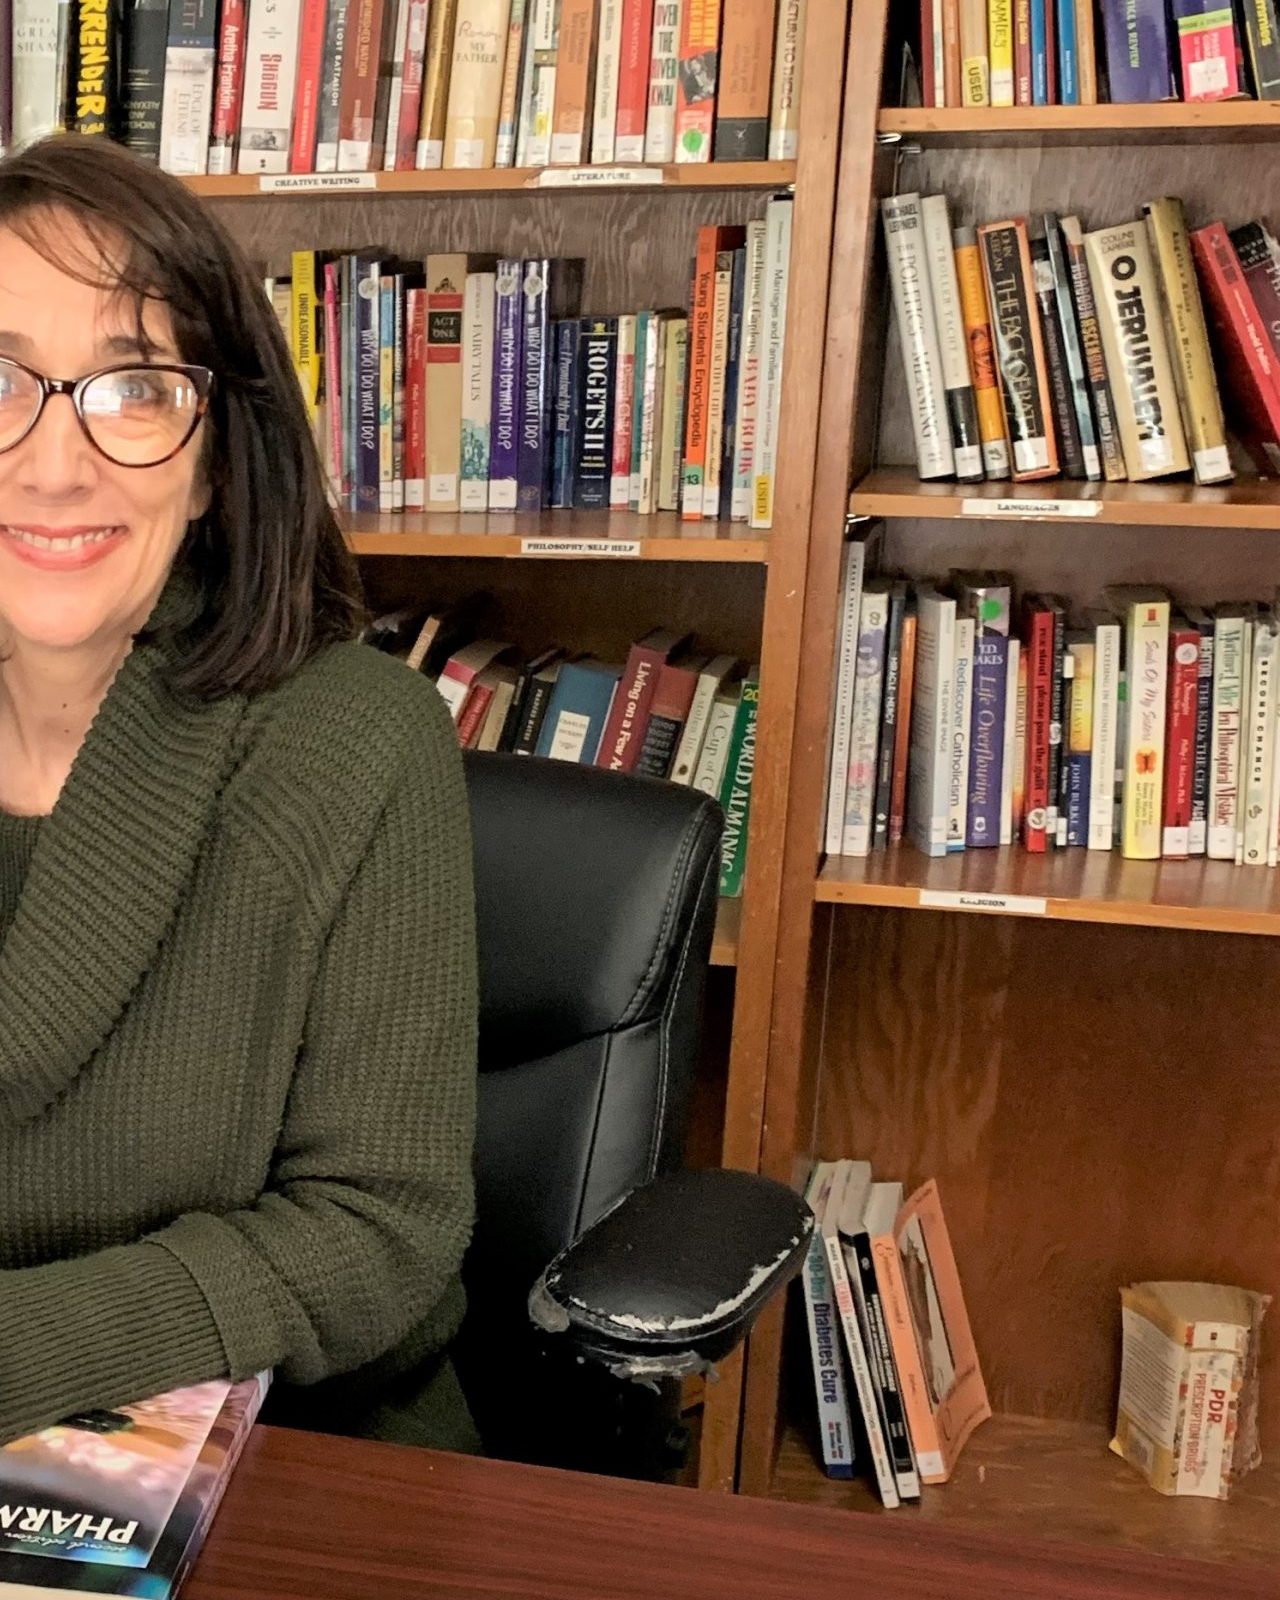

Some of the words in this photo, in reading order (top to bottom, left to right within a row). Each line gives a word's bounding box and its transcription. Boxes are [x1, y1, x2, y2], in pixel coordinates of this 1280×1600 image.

[337, 7, 346, 25] THE
[992, 0, 1008, 48] MMIES
[222, 25, 239, 62] Aretha
[335, 28, 345, 51] LOST
[469, 42, 486, 52] MY
[659, 31, 674, 52] THE
[1128, 33, 1141, 68] REVIEW
[75, 0, 110, 118] RRENDER
[357, 51, 370, 77] NATION
[455, 53, 498, 64] FATHER
[783, 46, 796, 64] TO
[219, 66, 238, 110] Franklin
[331, 54, 343, 107] BATTALION
[967, 66, 984, 103] USED
[274, 179, 319, 187] CREATIVE
[321, 177, 360, 185] WRITING
[572, 172, 631, 181] LITERATURE
[754, 227, 766, 260] Better
[991, 231, 1004, 273] KEEGAN
[751, 261, 764, 299] Homes
[1111, 255, 1137, 281] O
[695, 271, 711, 308] Young
[769, 269, 784, 318] Marriages
[899, 255, 925, 336] POLITICS
[996, 273, 1021, 316] THE
[298, 293, 311, 366] UNREASONABLE
[432, 329, 456, 339] ONE
[433, 317, 456, 326] ACT
[748, 308, 762, 355] Gardens
[769, 321, 781, 339] and
[360, 330, 376, 350] WHY
[473, 323, 483, 360] FAIRY
[500, 327, 515, 352] WHY
[526, 327, 541, 350] WHY
[694, 311, 709, 366] Students
[1000, 317, 1026, 359] FACE
[1081, 317, 1106, 383] ASCENDING
[1246, 323, 1261, 346] World
[1256, 346, 1271, 376] Politics
[360, 353, 375, 368] DO
[500, 353, 514, 366] DO
[526, 352, 539, 366] DO
[712, 340, 724, 395] BEAUTIFUL
[767, 341, 780, 381] Families
[1114, 285, 1166, 442] JERUSALEM
[360, 375, 375, 389] DO
[471, 362, 481, 401] TALES
[525, 373, 539, 387] DO
[558, 357, 572, 397] Promised
[584, 340, 609, 429] ROGET'S
[744, 358, 759, 408] BABY
[361, 390, 375, 418] WHAT
[498, 388, 513, 417] WHAT
[524, 388, 539, 417] WHAT
[555, 398, 570, 412] My
[690, 368, 706, 448] Encyclopedia
[710, 397, 720, 418] LIFE
[911, 350, 939, 439] MEANING
[524, 426, 539, 449] DO?
[557, 414, 569, 432] Dad
[360, 426, 375, 450] DO?
[497, 426, 512, 450] DO?
[583, 433, 605, 450] II
[738, 417, 755, 476] BOOK
[686, 474, 700, 486] 13
[756, 482, 769, 515] USED
[997, 503, 1060, 511] LANGUAGES
[527, 542, 609, 553] PHILOSOPHY/SELF
[611, 544, 635, 553] HELP
[1037, 649, 1048, 676] stout
[1144, 640, 1160, 667] Souls
[1198, 636, 1213, 678] MENTOR
[1219, 630, 1241, 675] Mortimer
[627, 661, 651, 703] Living
[888, 657, 898, 690] MIRACLE
[942, 680, 950, 696] THE
[1142, 668, 1159, 683] Of
[954, 658, 968, 728] Rediscover
[977, 674, 997, 706] Life
[1034, 685, 1046, 719] please
[1139, 687, 1158, 708] My
[1199, 682, 1210, 706] THE
[1258, 660, 1269, 718] SECOND
[622, 719, 632, 729] a
[626, 704, 638, 717] on
[718, 710, 730, 721] A
[885, 696, 896, 725] MERCY
[1198, 710, 1209, 732] KID
[1218, 709, 1239, 726] Ten
[709, 725, 728, 753] Cup
[1033, 720, 1045, 746] pass
[1140, 711, 1157, 742] Sisters
[615, 731, 633, 753] Few
[734, 725, 756, 784] WORLD
[1035, 747, 1045, 764] the
[1196, 741, 1208, 767] THE
[1214, 728, 1239, 784] Philosophical
[1254, 726, 1264, 783] CHANCE
[705, 761, 715, 772] of
[950, 732, 966, 806] Catholicism
[972, 709, 996, 805] Overflowing
[1070, 762, 1081, 790] JOHN
[1194, 768, 1206, 796] CEO
[1214, 786, 1237, 826] Mistakes
[720, 788, 749, 872] ALMANAC
[959, 897, 1007, 907] RELIGION
[812, 1302, 835, 1367] Diabetes
[820, 1368, 838, 1405] Cure
[1188, 1372, 1207, 1439] PRESCRIPTION
[1206, 1388, 1226, 1425] PDR
[1184, 1440, 1201, 1473] DRUGS
[4, 1531, 68, 1549] edition
